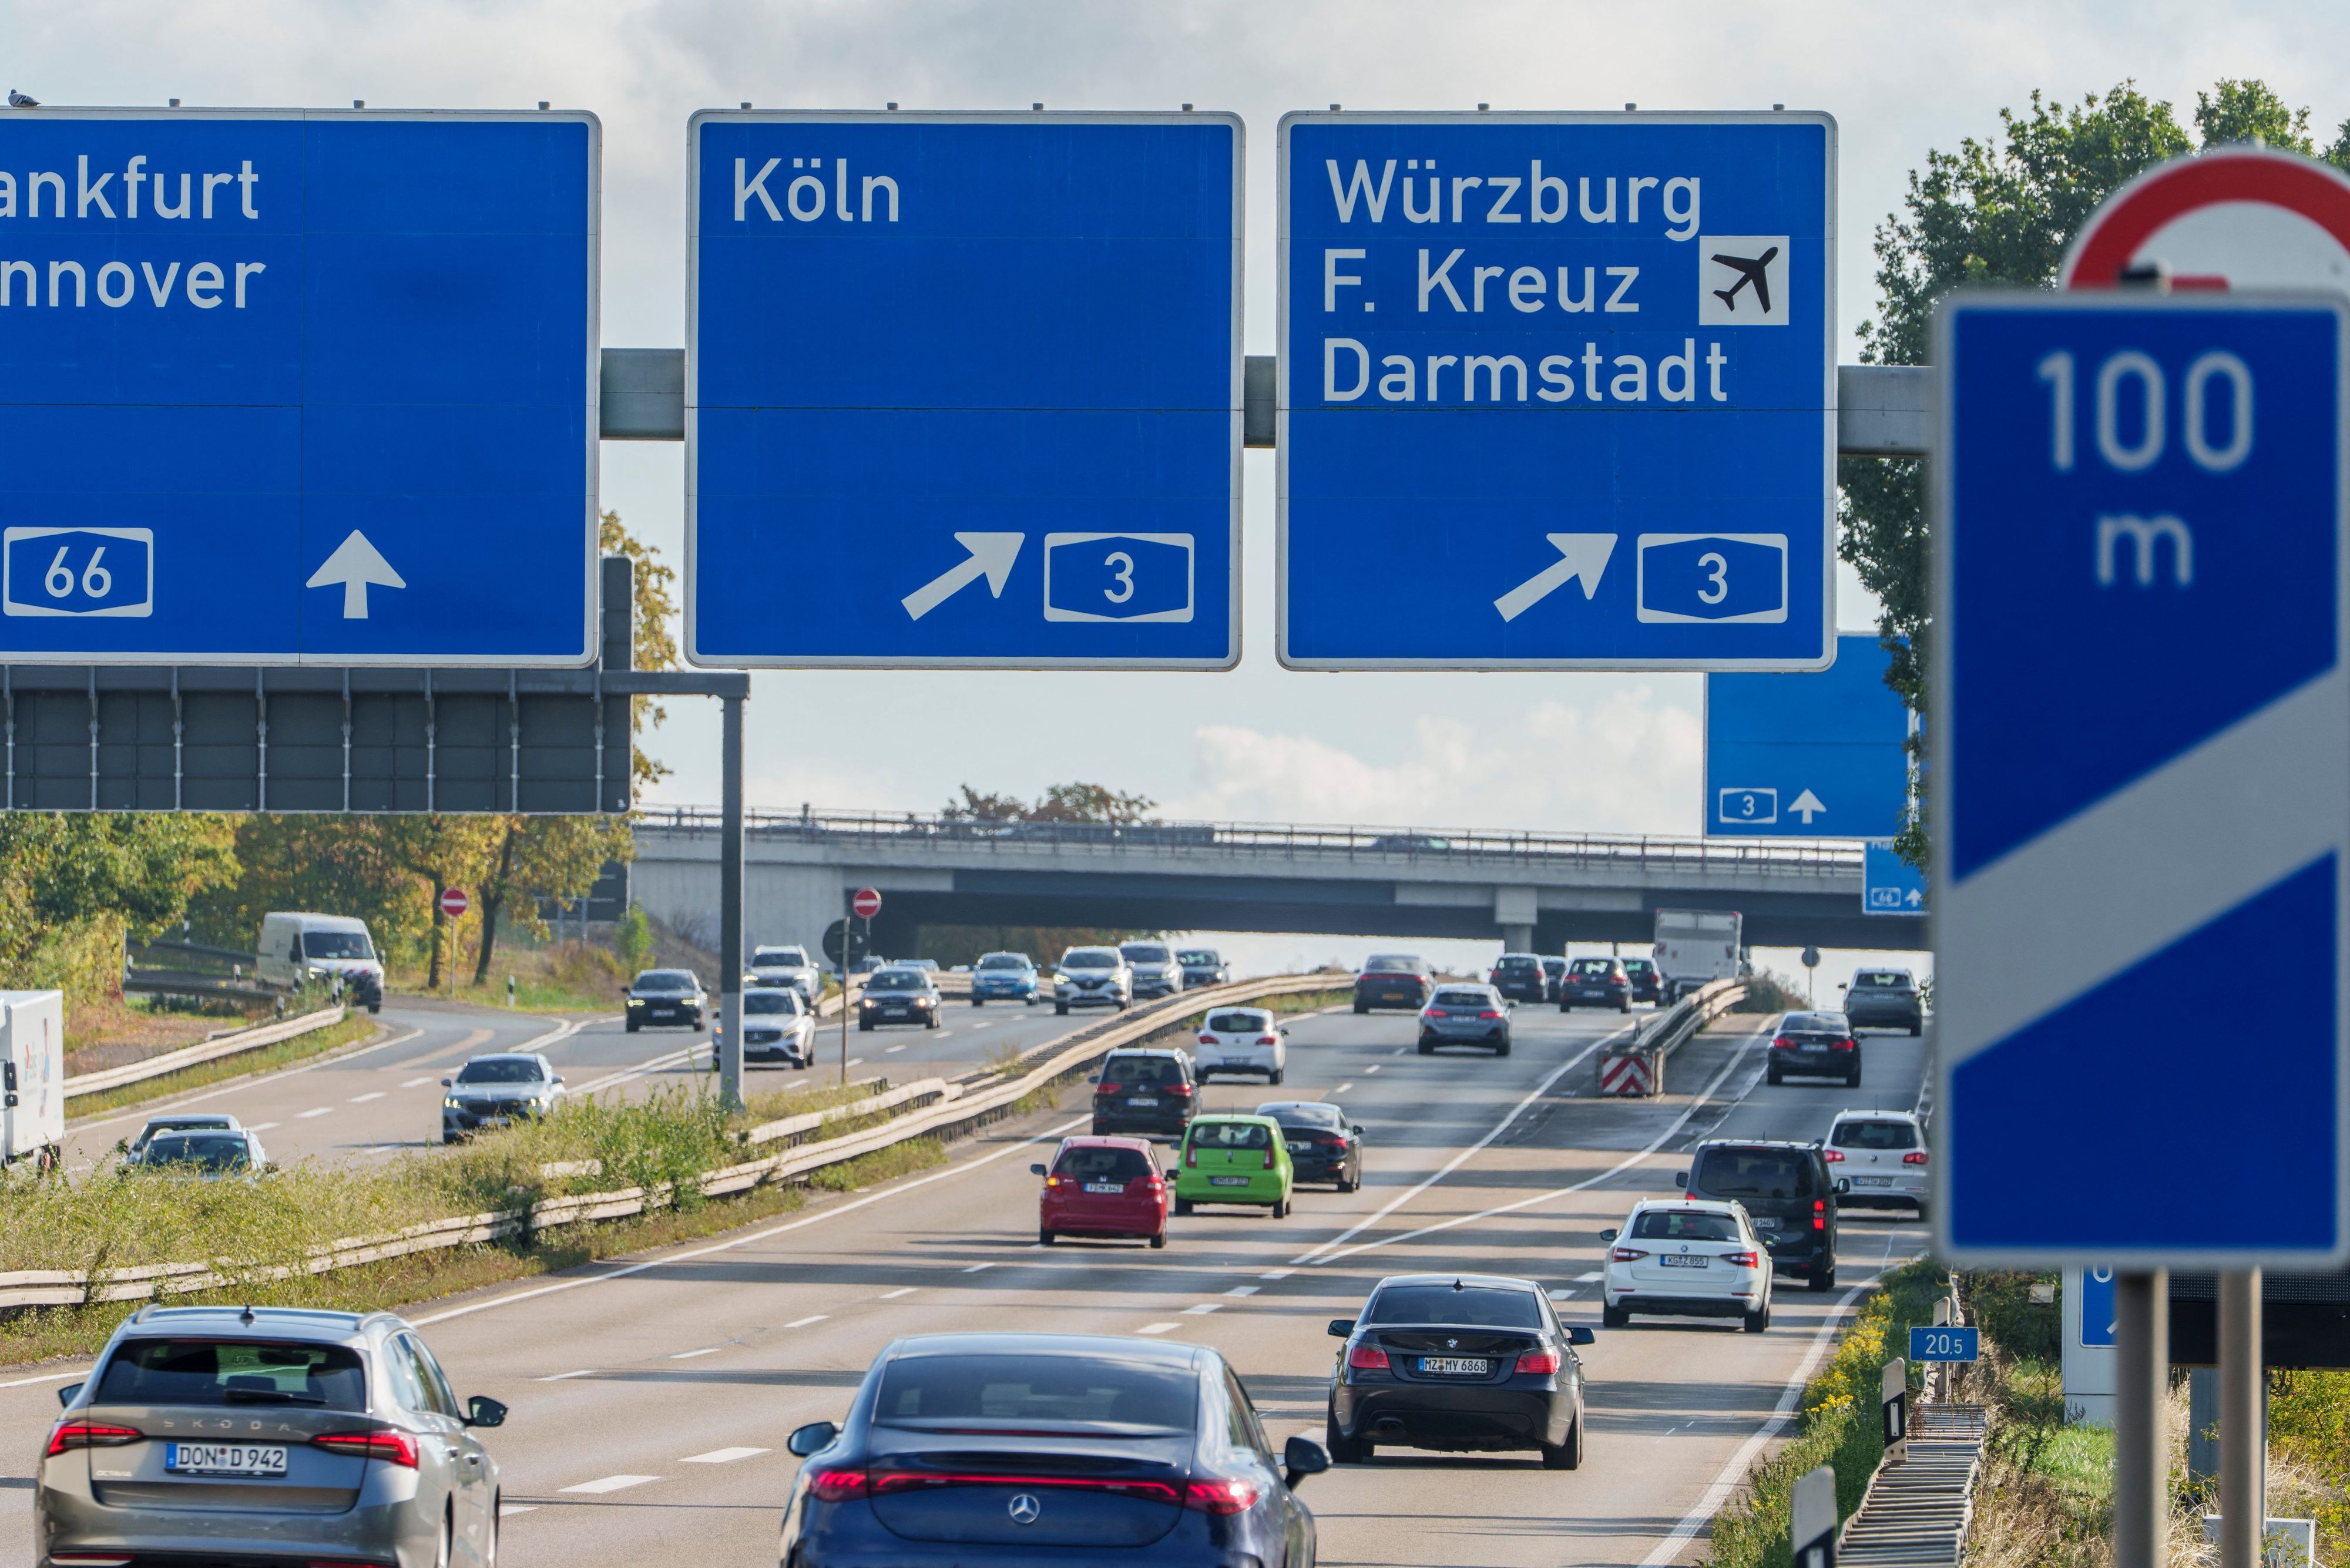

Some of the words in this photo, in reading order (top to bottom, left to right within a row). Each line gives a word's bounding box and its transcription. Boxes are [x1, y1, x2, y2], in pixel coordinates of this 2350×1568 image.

[734, 157, 899, 222] Köln
[1326, 159, 1700, 241] Würzburg
[0, 260, 267, 309] nnover
[1324, 249, 1375, 313] F.
[1418, 249, 1640, 313] Kreuz
[1324, 338, 1728, 402] Darmstadt
[2036, 350, 2254, 472] 100
[44, 546, 112, 598] 66
[2096, 512, 2194, 587] m
[1103, 551, 1134, 603] 3
[1697, 552, 1728, 605] 3
[1742, 795, 1754, 816] 3
[1879, 891, 1893, 903] 66
[1668, 1256, 1678, 1265] KG
[1690, 1257, 1704, 1265] 855
[1425, 1359, 1438, 1370] MZ
[1445, 1359, 1458, 1371] MY
[1461, 1361, 1486, 1372] 6868
[1925, 1334, 1963, 1355] 20,5
[179, 1446, 218, 1466] DON
[230, 1448, 242, 1467] D
[249, 1449, 284, 1469] 942
